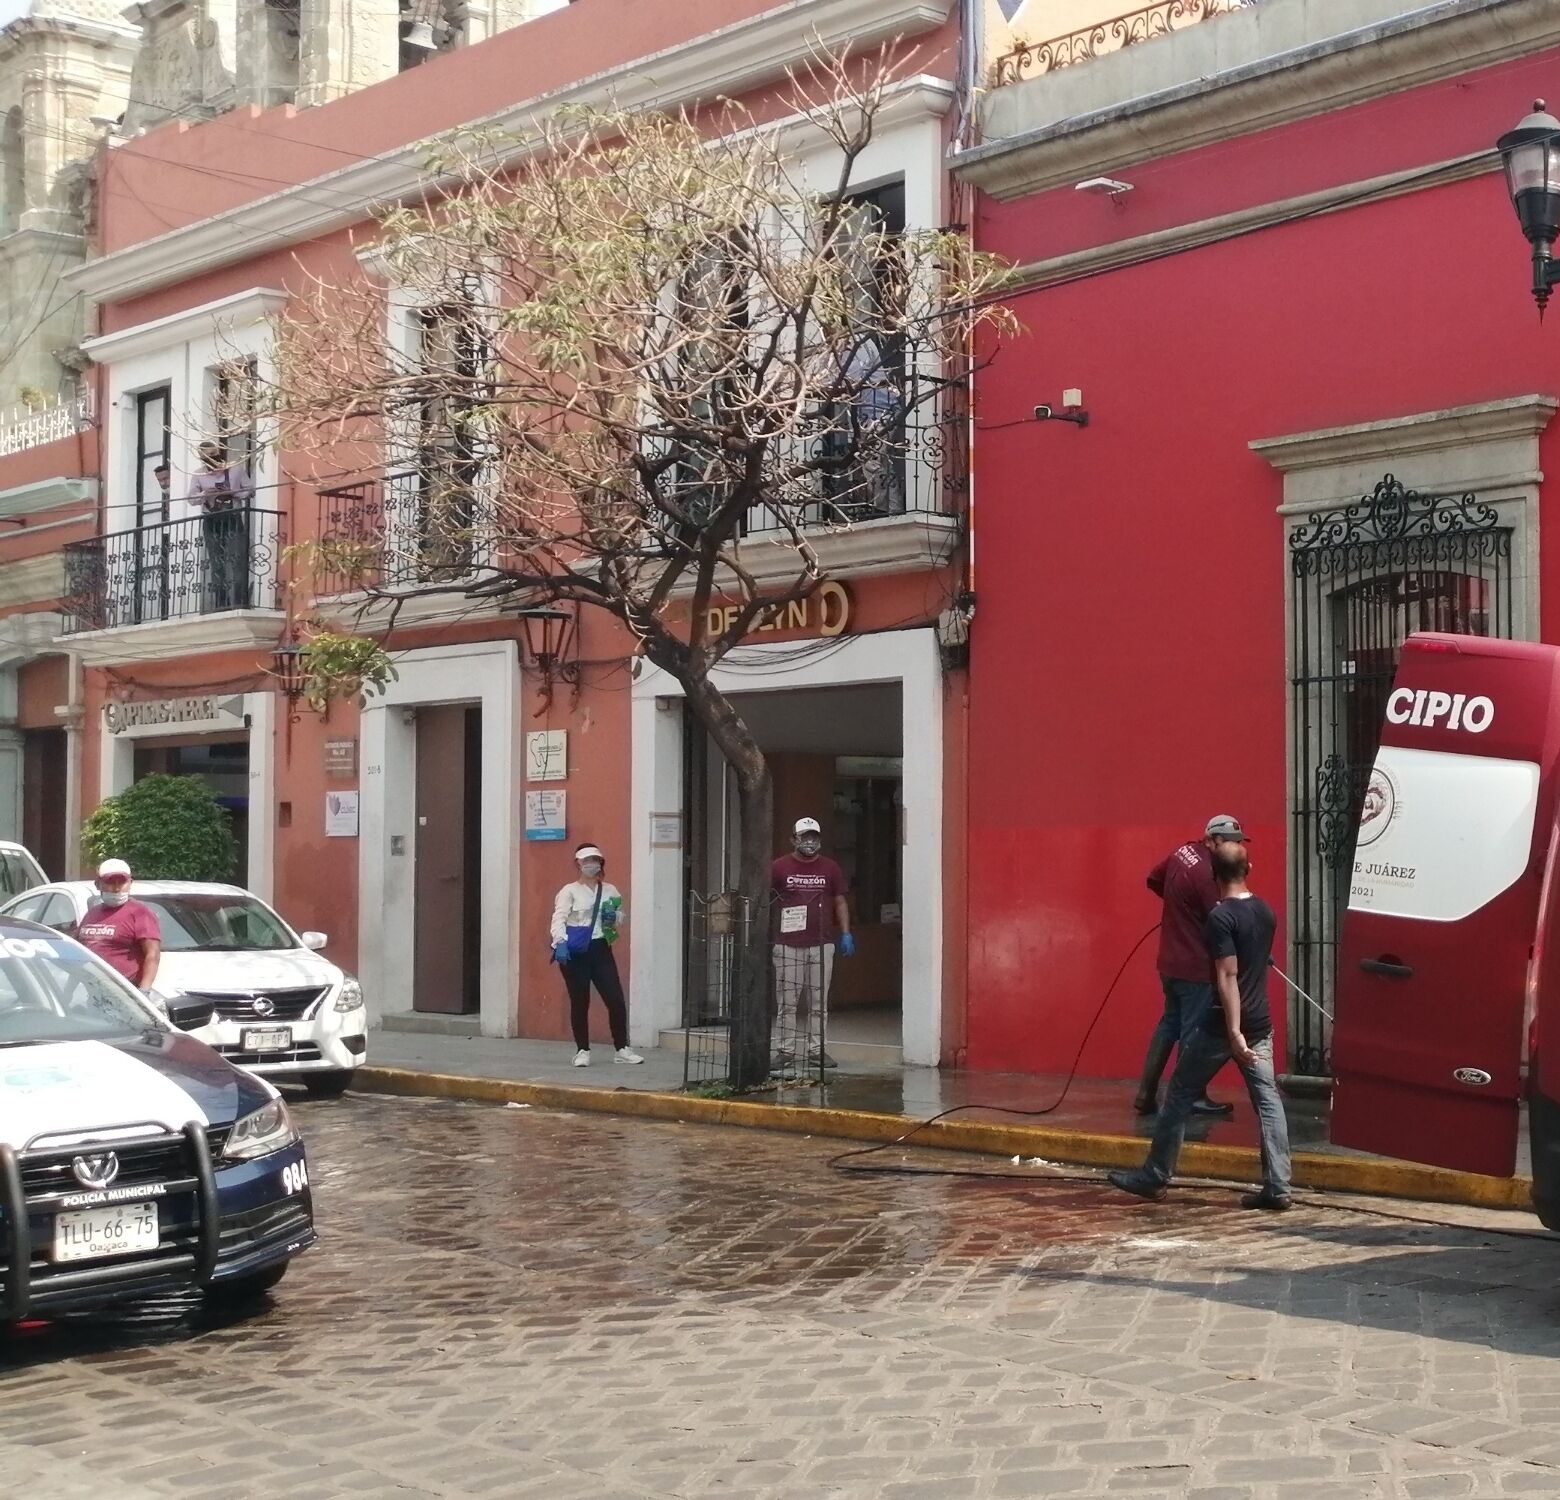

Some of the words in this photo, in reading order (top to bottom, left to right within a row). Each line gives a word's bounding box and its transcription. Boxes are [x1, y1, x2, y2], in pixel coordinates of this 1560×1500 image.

[1386, 687, 1495, 733] CIPIO
[1365, 862, 1416, 880] JUÁREZ
[80, 924, 116, 936] razón
[283, 1158, 308, 1195] 984
[108, 1184, 167, 1200] MUNICIPAL
[61, 1215, 154, 1246] TLU-66-75
